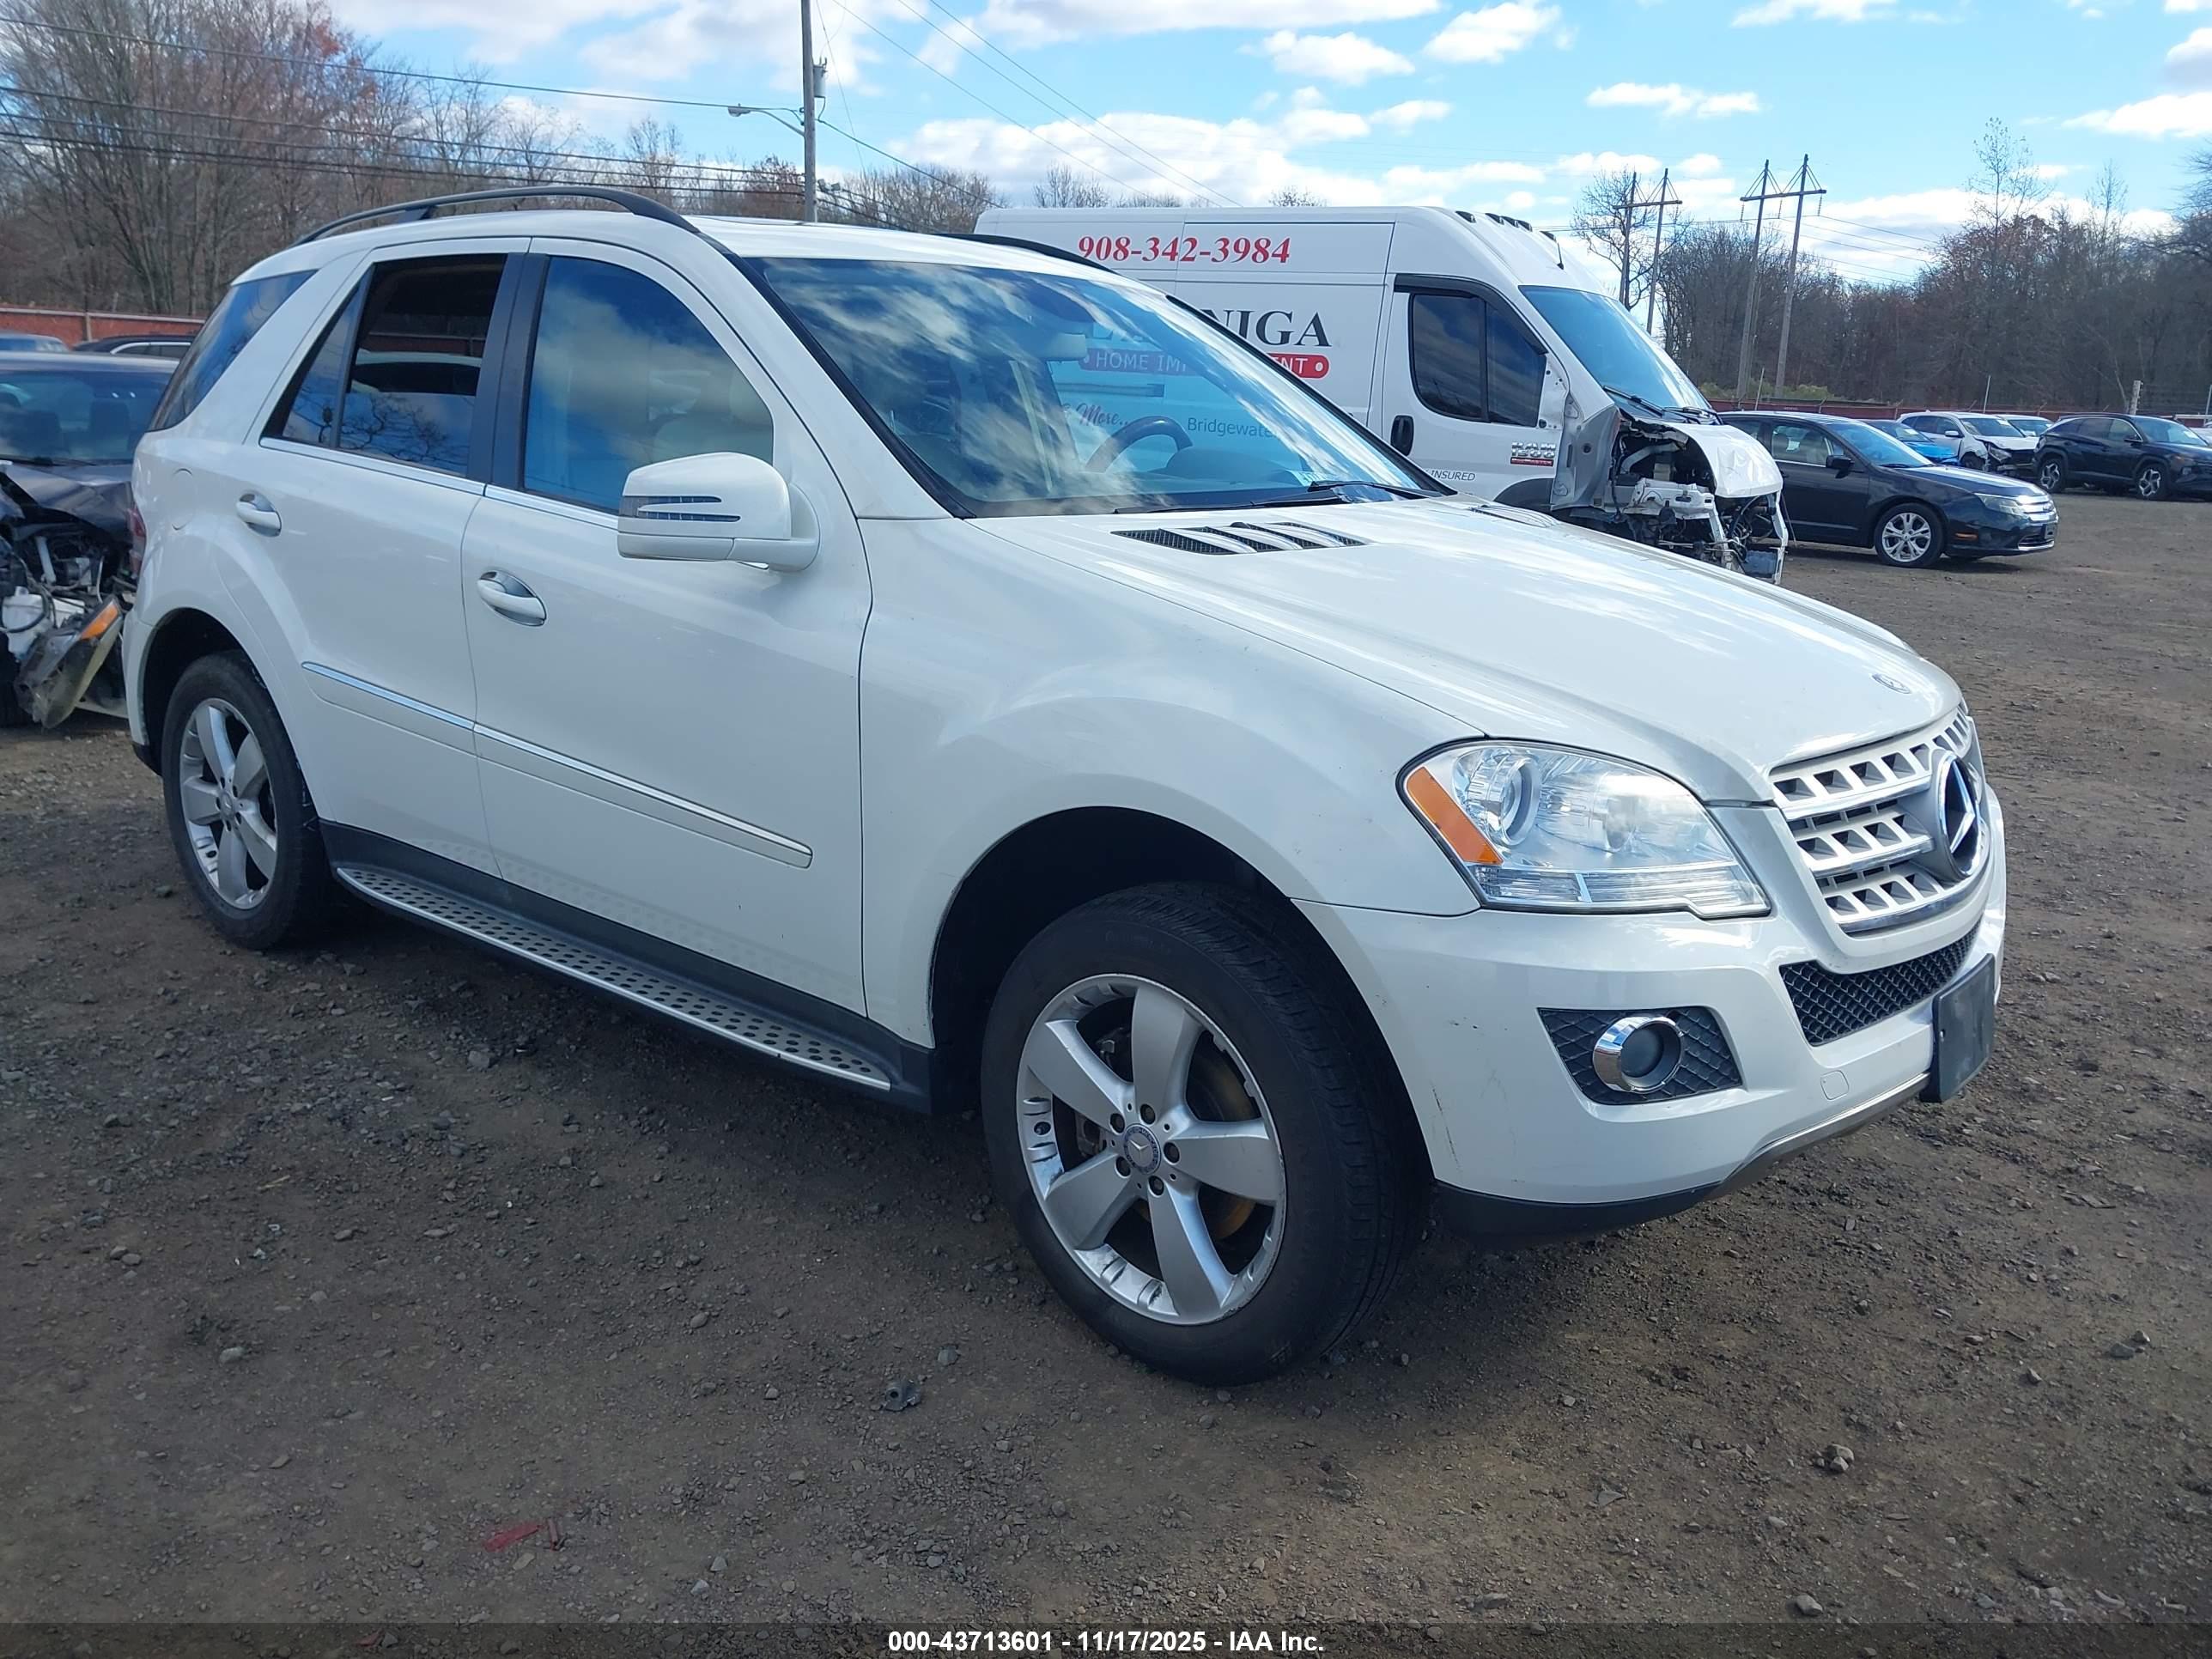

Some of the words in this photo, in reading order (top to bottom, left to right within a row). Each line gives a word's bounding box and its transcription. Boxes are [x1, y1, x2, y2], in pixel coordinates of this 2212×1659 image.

[1079, 236, 1291, 264] 908-342-3984
[1096, 351, 1148, 370] HOME
[1511, 441, 1556, 451] RAM
[1431, 470, 1475, 481] INSURED
